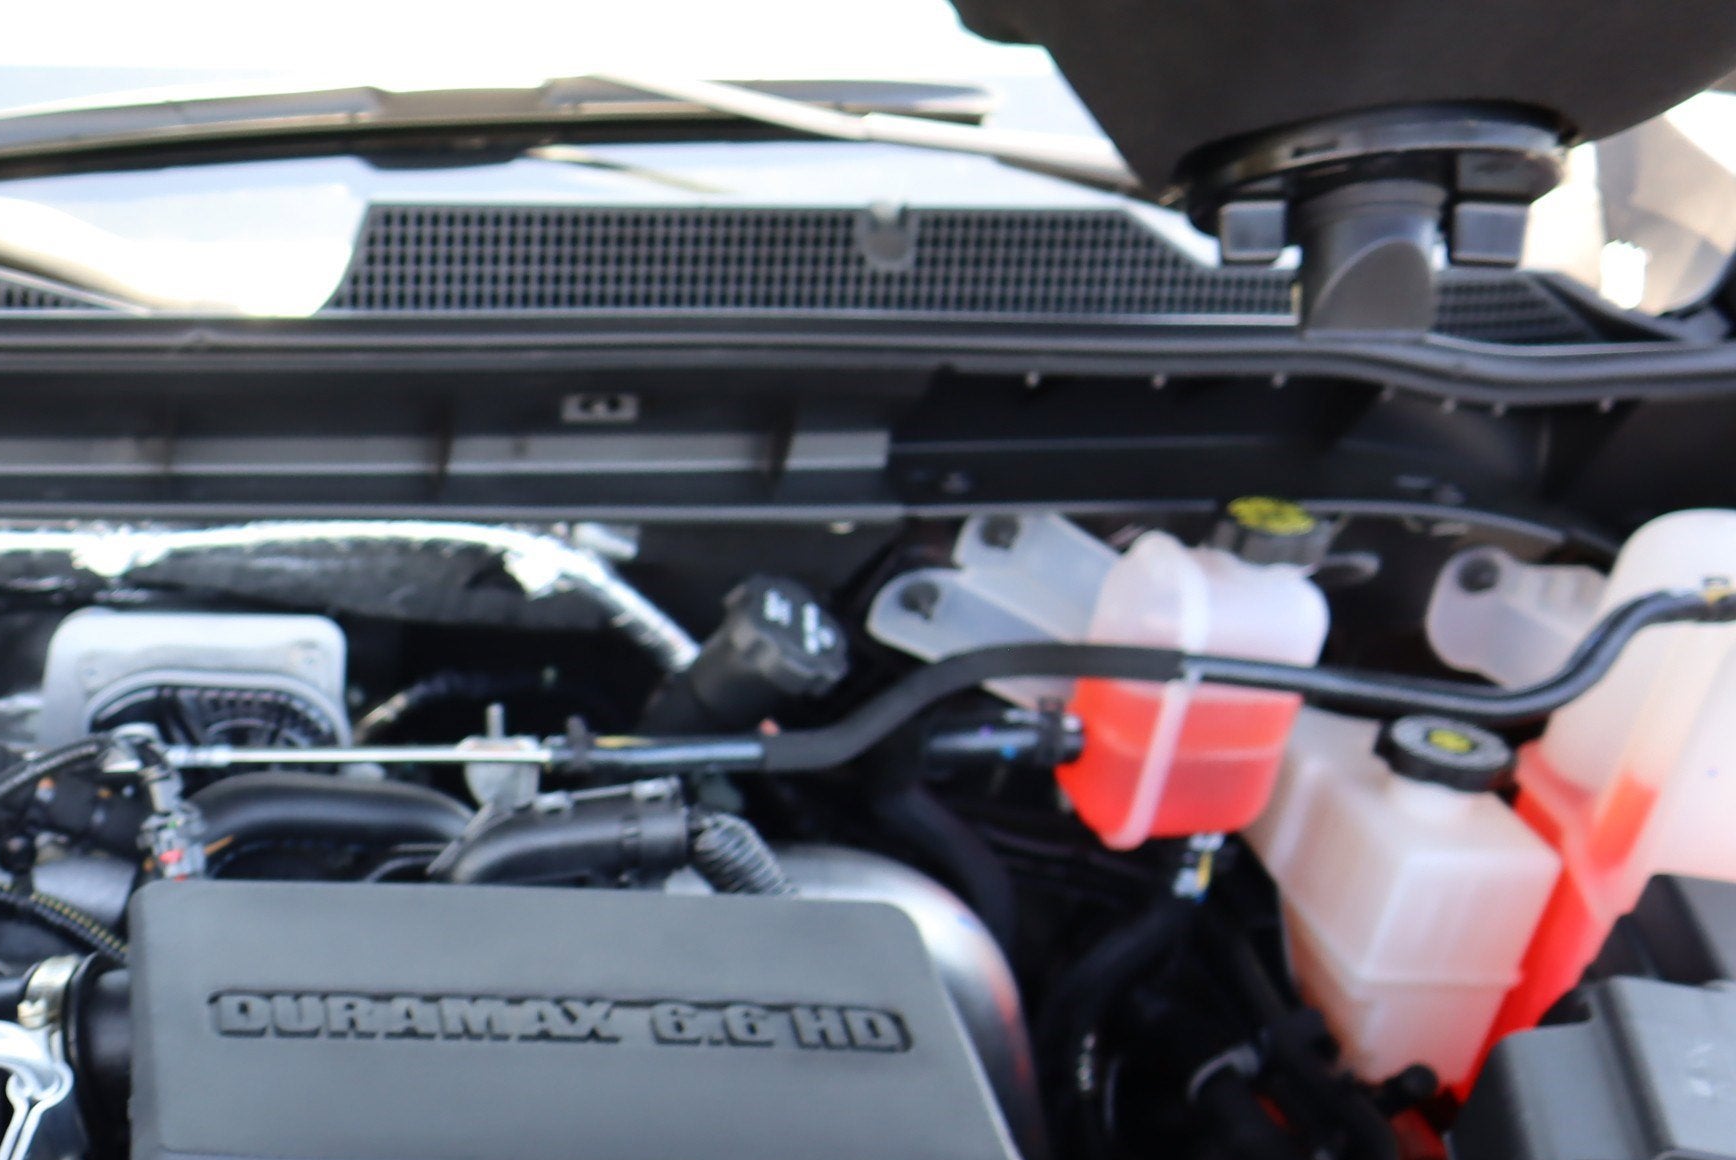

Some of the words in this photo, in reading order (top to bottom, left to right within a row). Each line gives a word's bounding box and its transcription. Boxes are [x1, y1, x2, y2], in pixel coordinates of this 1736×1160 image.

[210, 990, 620, 1042] DURAMAX
[650, 1000, 775, 1047] 6.6
[788, 1002, 912, 1051] HD
